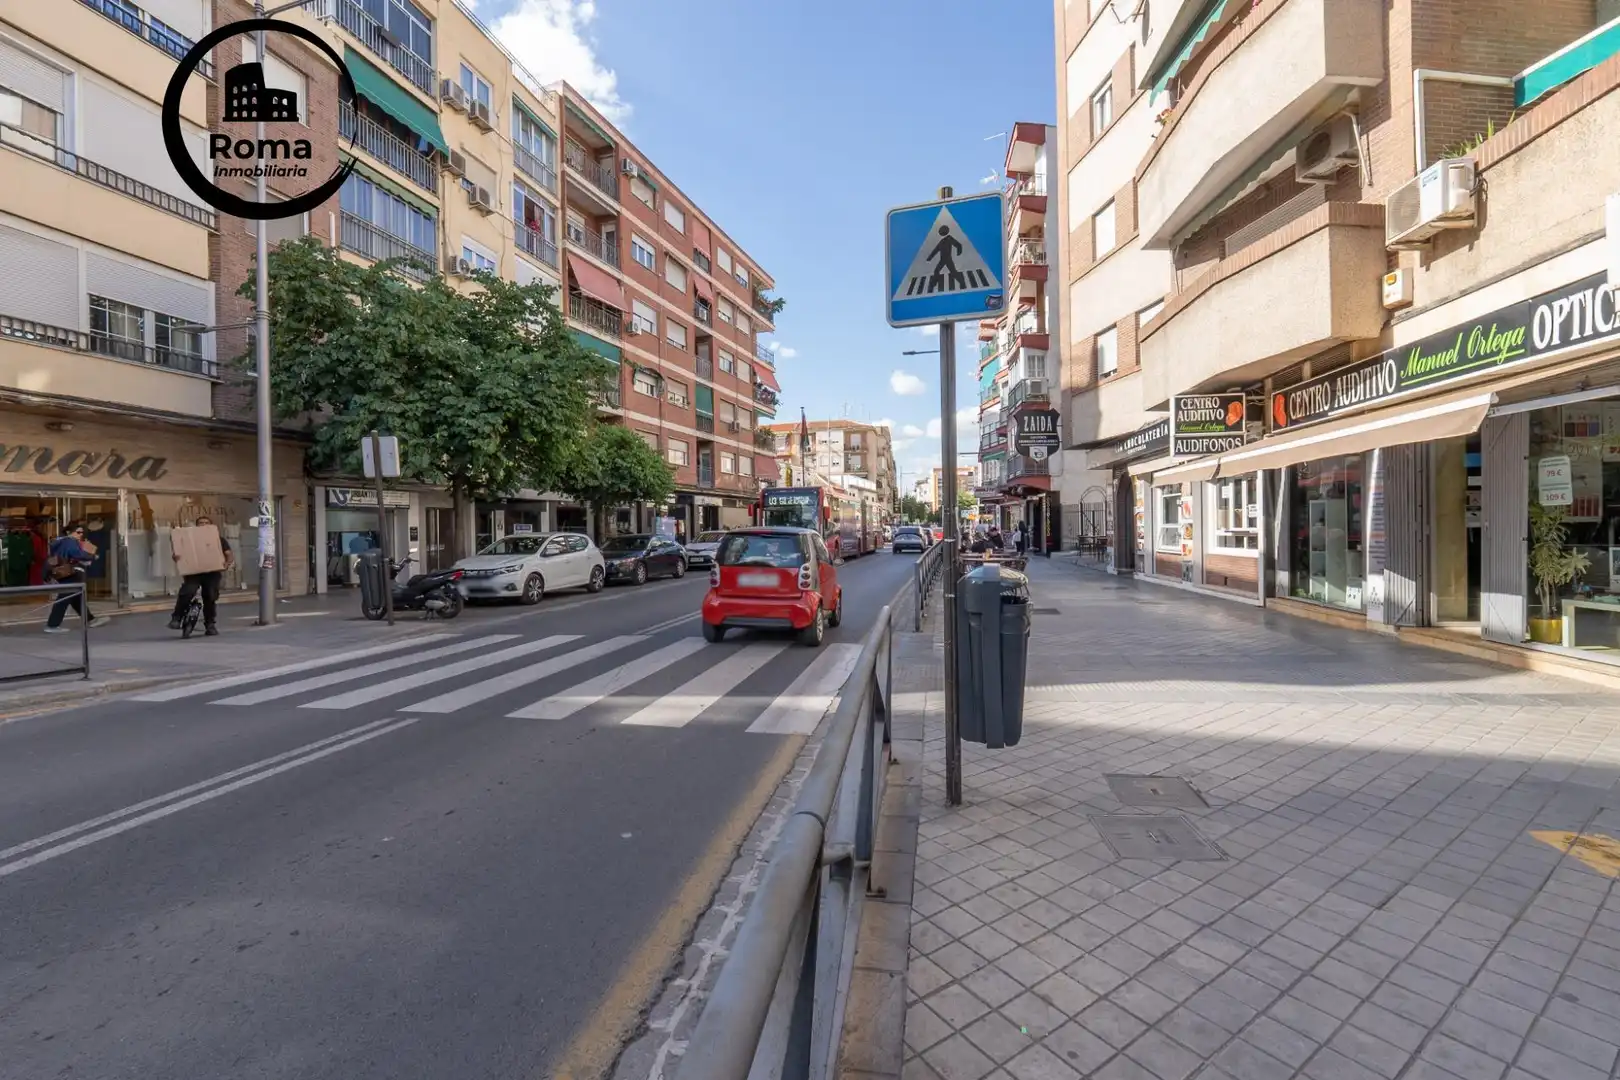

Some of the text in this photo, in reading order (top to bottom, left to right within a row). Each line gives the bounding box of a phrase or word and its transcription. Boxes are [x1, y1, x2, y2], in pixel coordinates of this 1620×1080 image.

[1400, 323, 1526, 378] Manuel Ortega
[1289, 358, 1397, 419] CENTRO AUDITIVO
[1180, 397, 1220, 410] CENTRO
[1023, 415, 1053, 432] ZAIDA
[1177, 408, 1225, 422] AUDITIVO
[1123, 423, 1169, 450] CHOCOLATERÍA
[1175, 437, 1242, 453] AUDIFONOS
